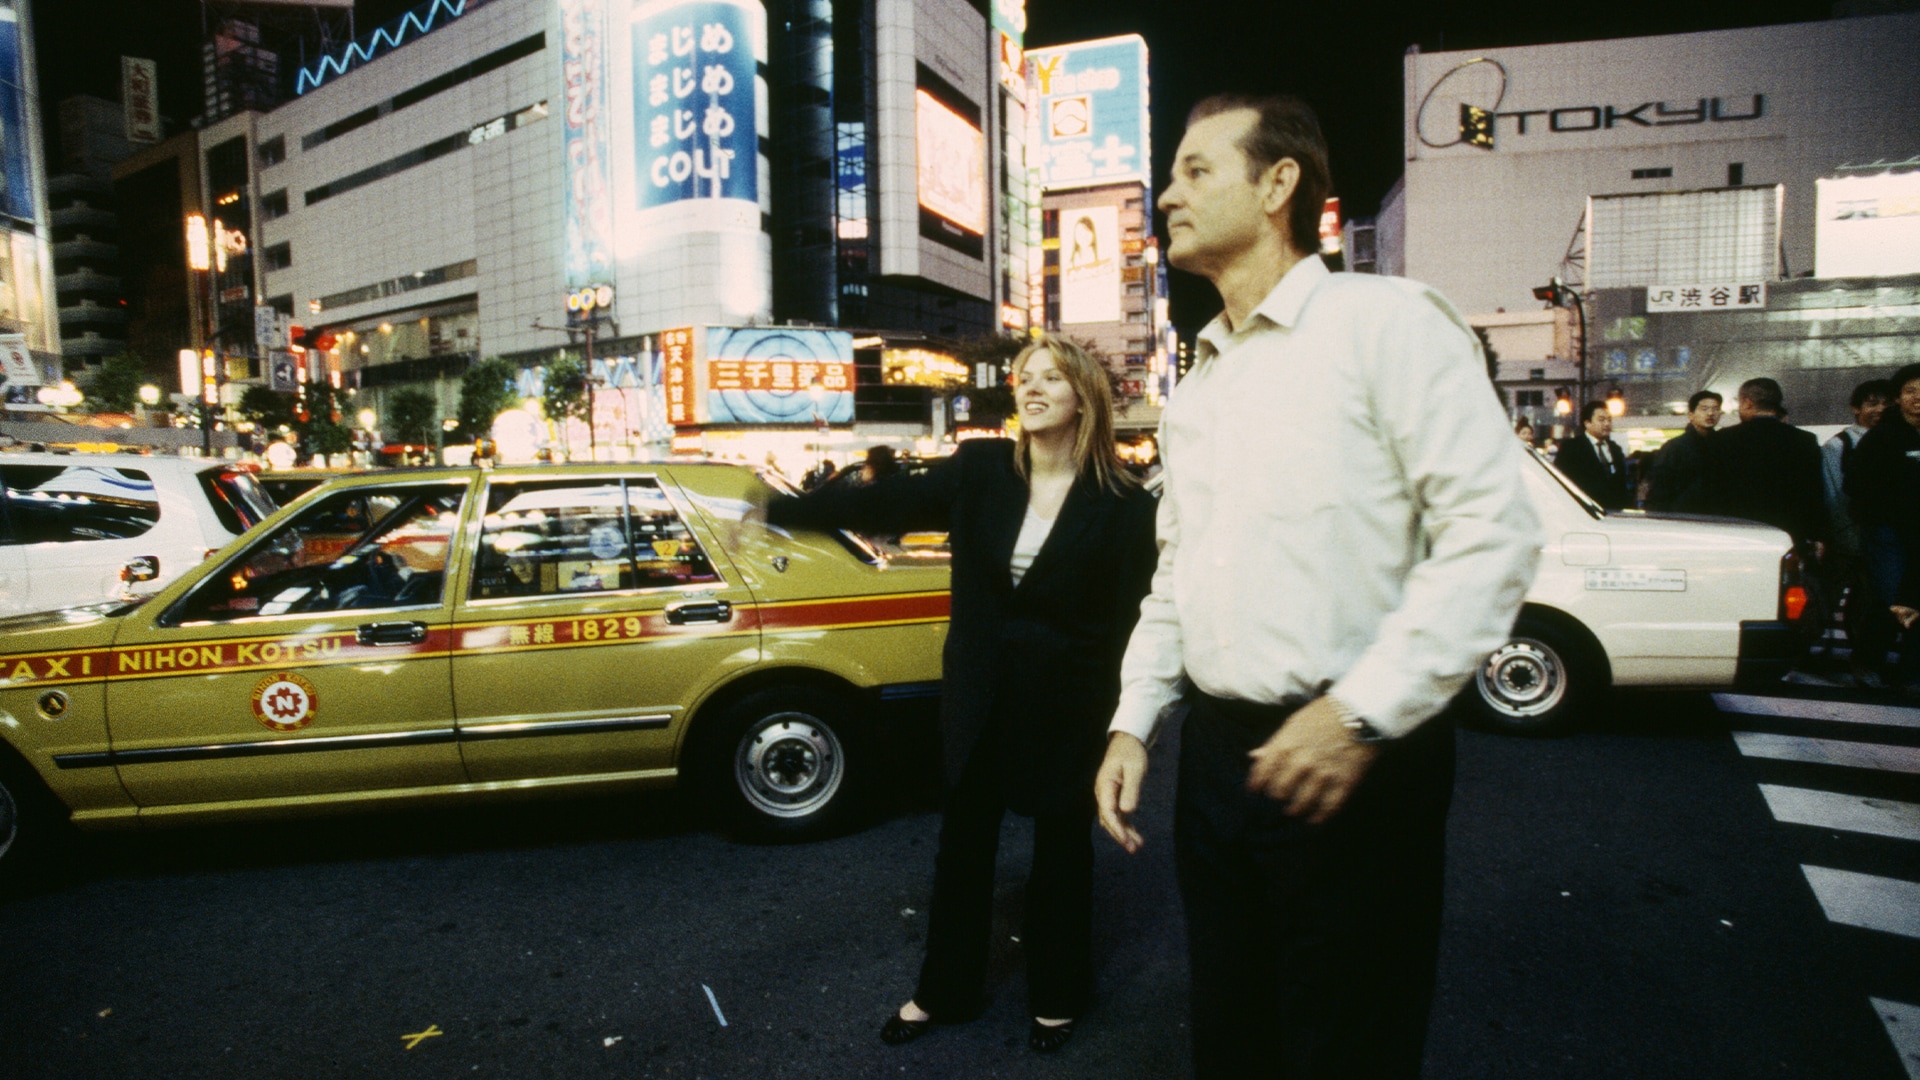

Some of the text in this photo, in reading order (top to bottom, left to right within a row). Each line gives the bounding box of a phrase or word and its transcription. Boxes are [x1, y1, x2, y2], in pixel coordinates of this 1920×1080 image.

[649, 23, 733, 65] まじめ
[649, 64, 734, 107] まじめ
[649, 106, 735, 147] まじめ
[1497, 94, 1764, 135] TOKYU
[651, 149, 735, 187] COLT
[717, 363, 847, 388] 三千里薬品
[510, 617, 641, 645] 無線 1829
[0, 638, 343, 680] AXI NIHON KOTSU
[276, 695, 294, 711] N
